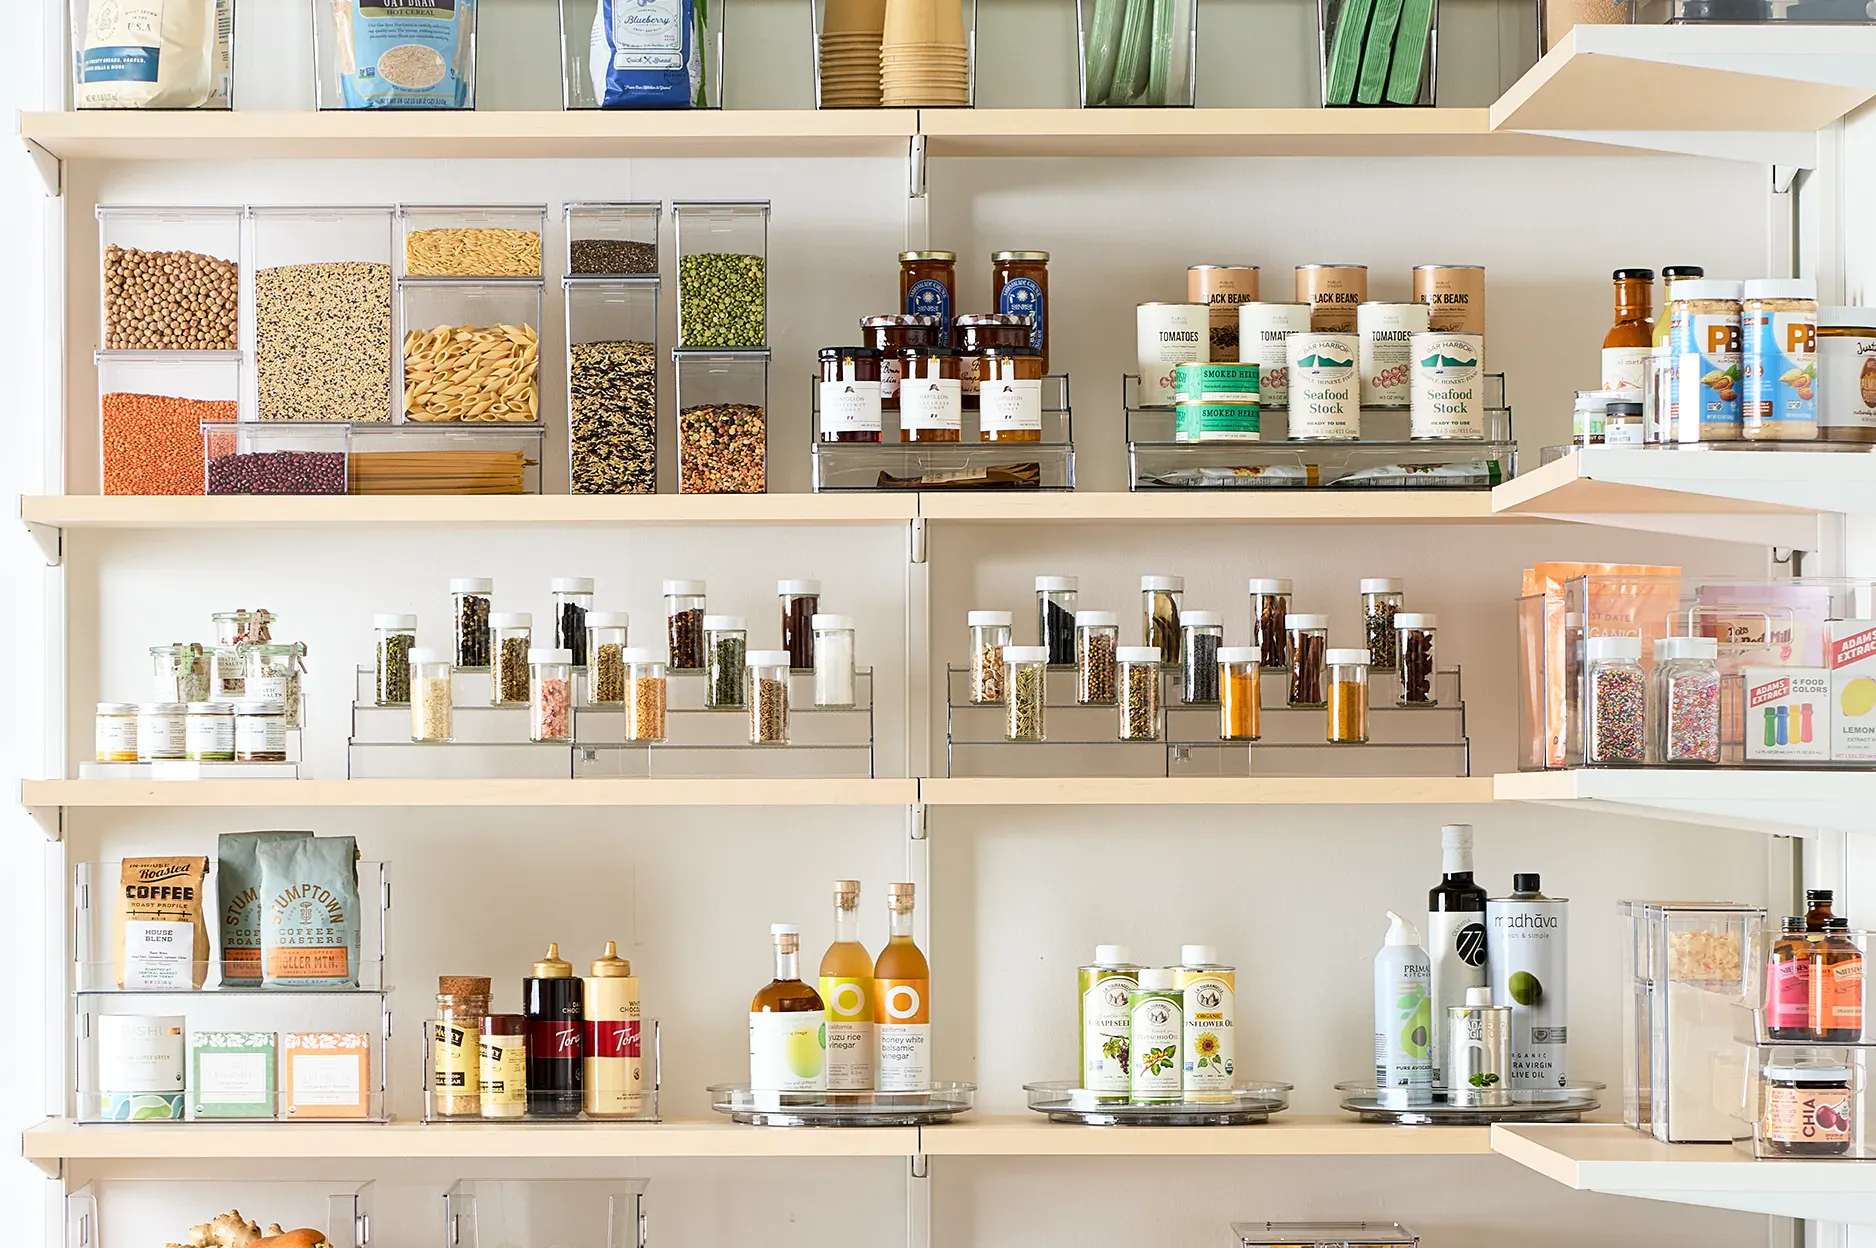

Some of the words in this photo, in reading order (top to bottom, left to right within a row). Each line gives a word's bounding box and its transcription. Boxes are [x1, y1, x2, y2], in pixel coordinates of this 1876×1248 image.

[624, 15, 671, 26] Blueberry
[1227, 293, 1251, 304] BEANS
[1335, 293, 1359, 304] BEANS
[1443, 294, 1469, 304] BEANS
[1159, 331, 1199, 342] TOMATOES
[1260, 331, 1299, 342] TOMAT
[1372, 331, 1412, 342] TOMATOES
[1303, 344, 1318, 354] BAR
[1319, 342, 1350, 354] HARBOR
[1203, 370, 1237, 378] SMOKED
[1303, 389, 1349, 400] Seafood
[1427, 388, 1472, 400] Seafood
[1202, 409, 1235, 417] SMOKED
[1309, 402, 1344, 414] Stock
[1433, 402, 1468, 414] Stock
[1604, 613, 1630, 622] DATE
[1837, 640, 1876, 664] EXTRAC
[1755, 680, 1785, 696] ADAMS
[1752, 686, 1789, 705] EXTRACT
[1842, 726, 1875, 734] LEMON
[139, 864, 191, 879] Roasted
[125, 885, 194, 901] COFFEE
[271, 883, 344, 925] STUMPTOWN
[235, 929, 261, 937] COF
[278, 928, 334, 936] COFFEE
[1404, 964, 1430, 973] PRIMA
[555, 1028, 580, 1052] Tora
[612, 1028, 640, 1052] Tora
[828, 1034, 845, 1042] yuzu
[847, 1033, 861, 1041] rice
[882, 1036, 904, 1044] honey
[905, 1036, 924, 1044] white
[828, 1041, 856, 1050] vinegar
[1803, 1098, 1816, 1138] CHIA
